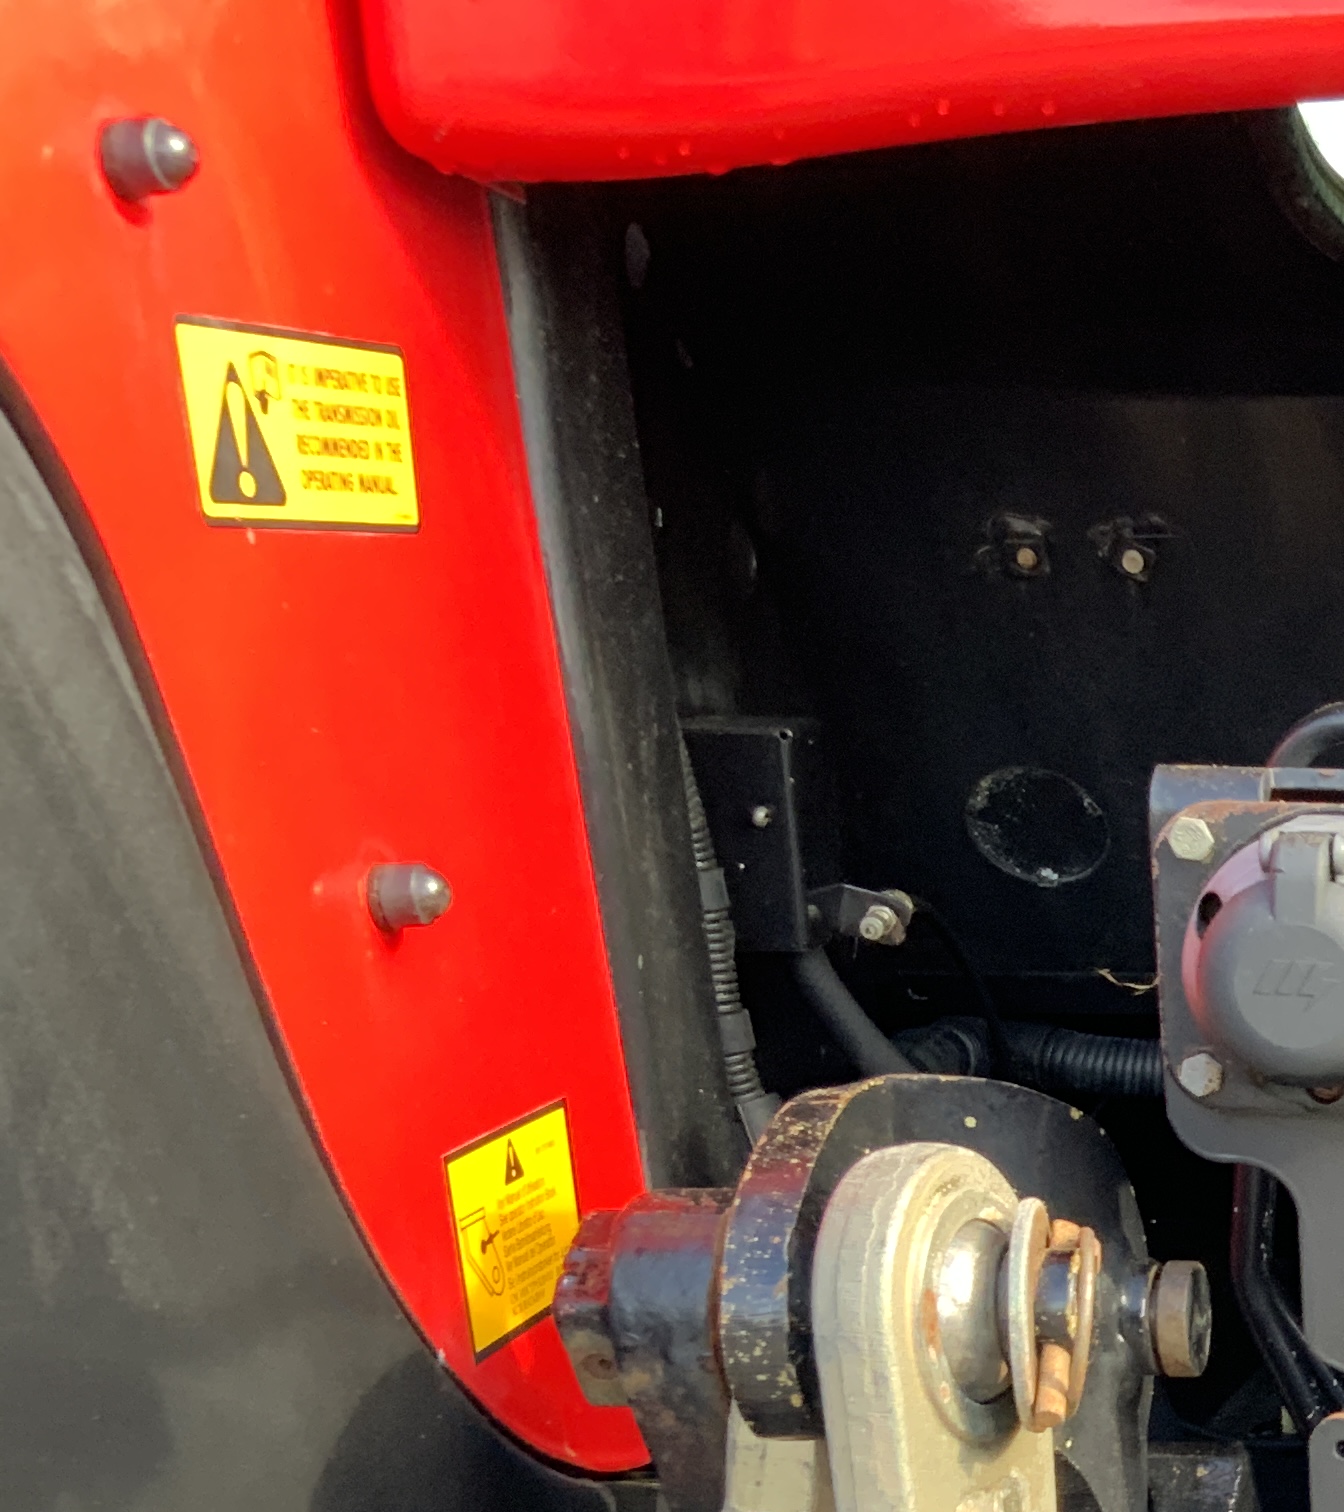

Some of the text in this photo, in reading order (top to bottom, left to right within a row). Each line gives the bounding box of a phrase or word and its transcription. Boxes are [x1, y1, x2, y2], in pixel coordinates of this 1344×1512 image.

[313, 401, 383, 427] TRANSMISSION
[296, 433, 370, 461] RECOMMENDED
[301, 469, 355, 493] OPERATING
